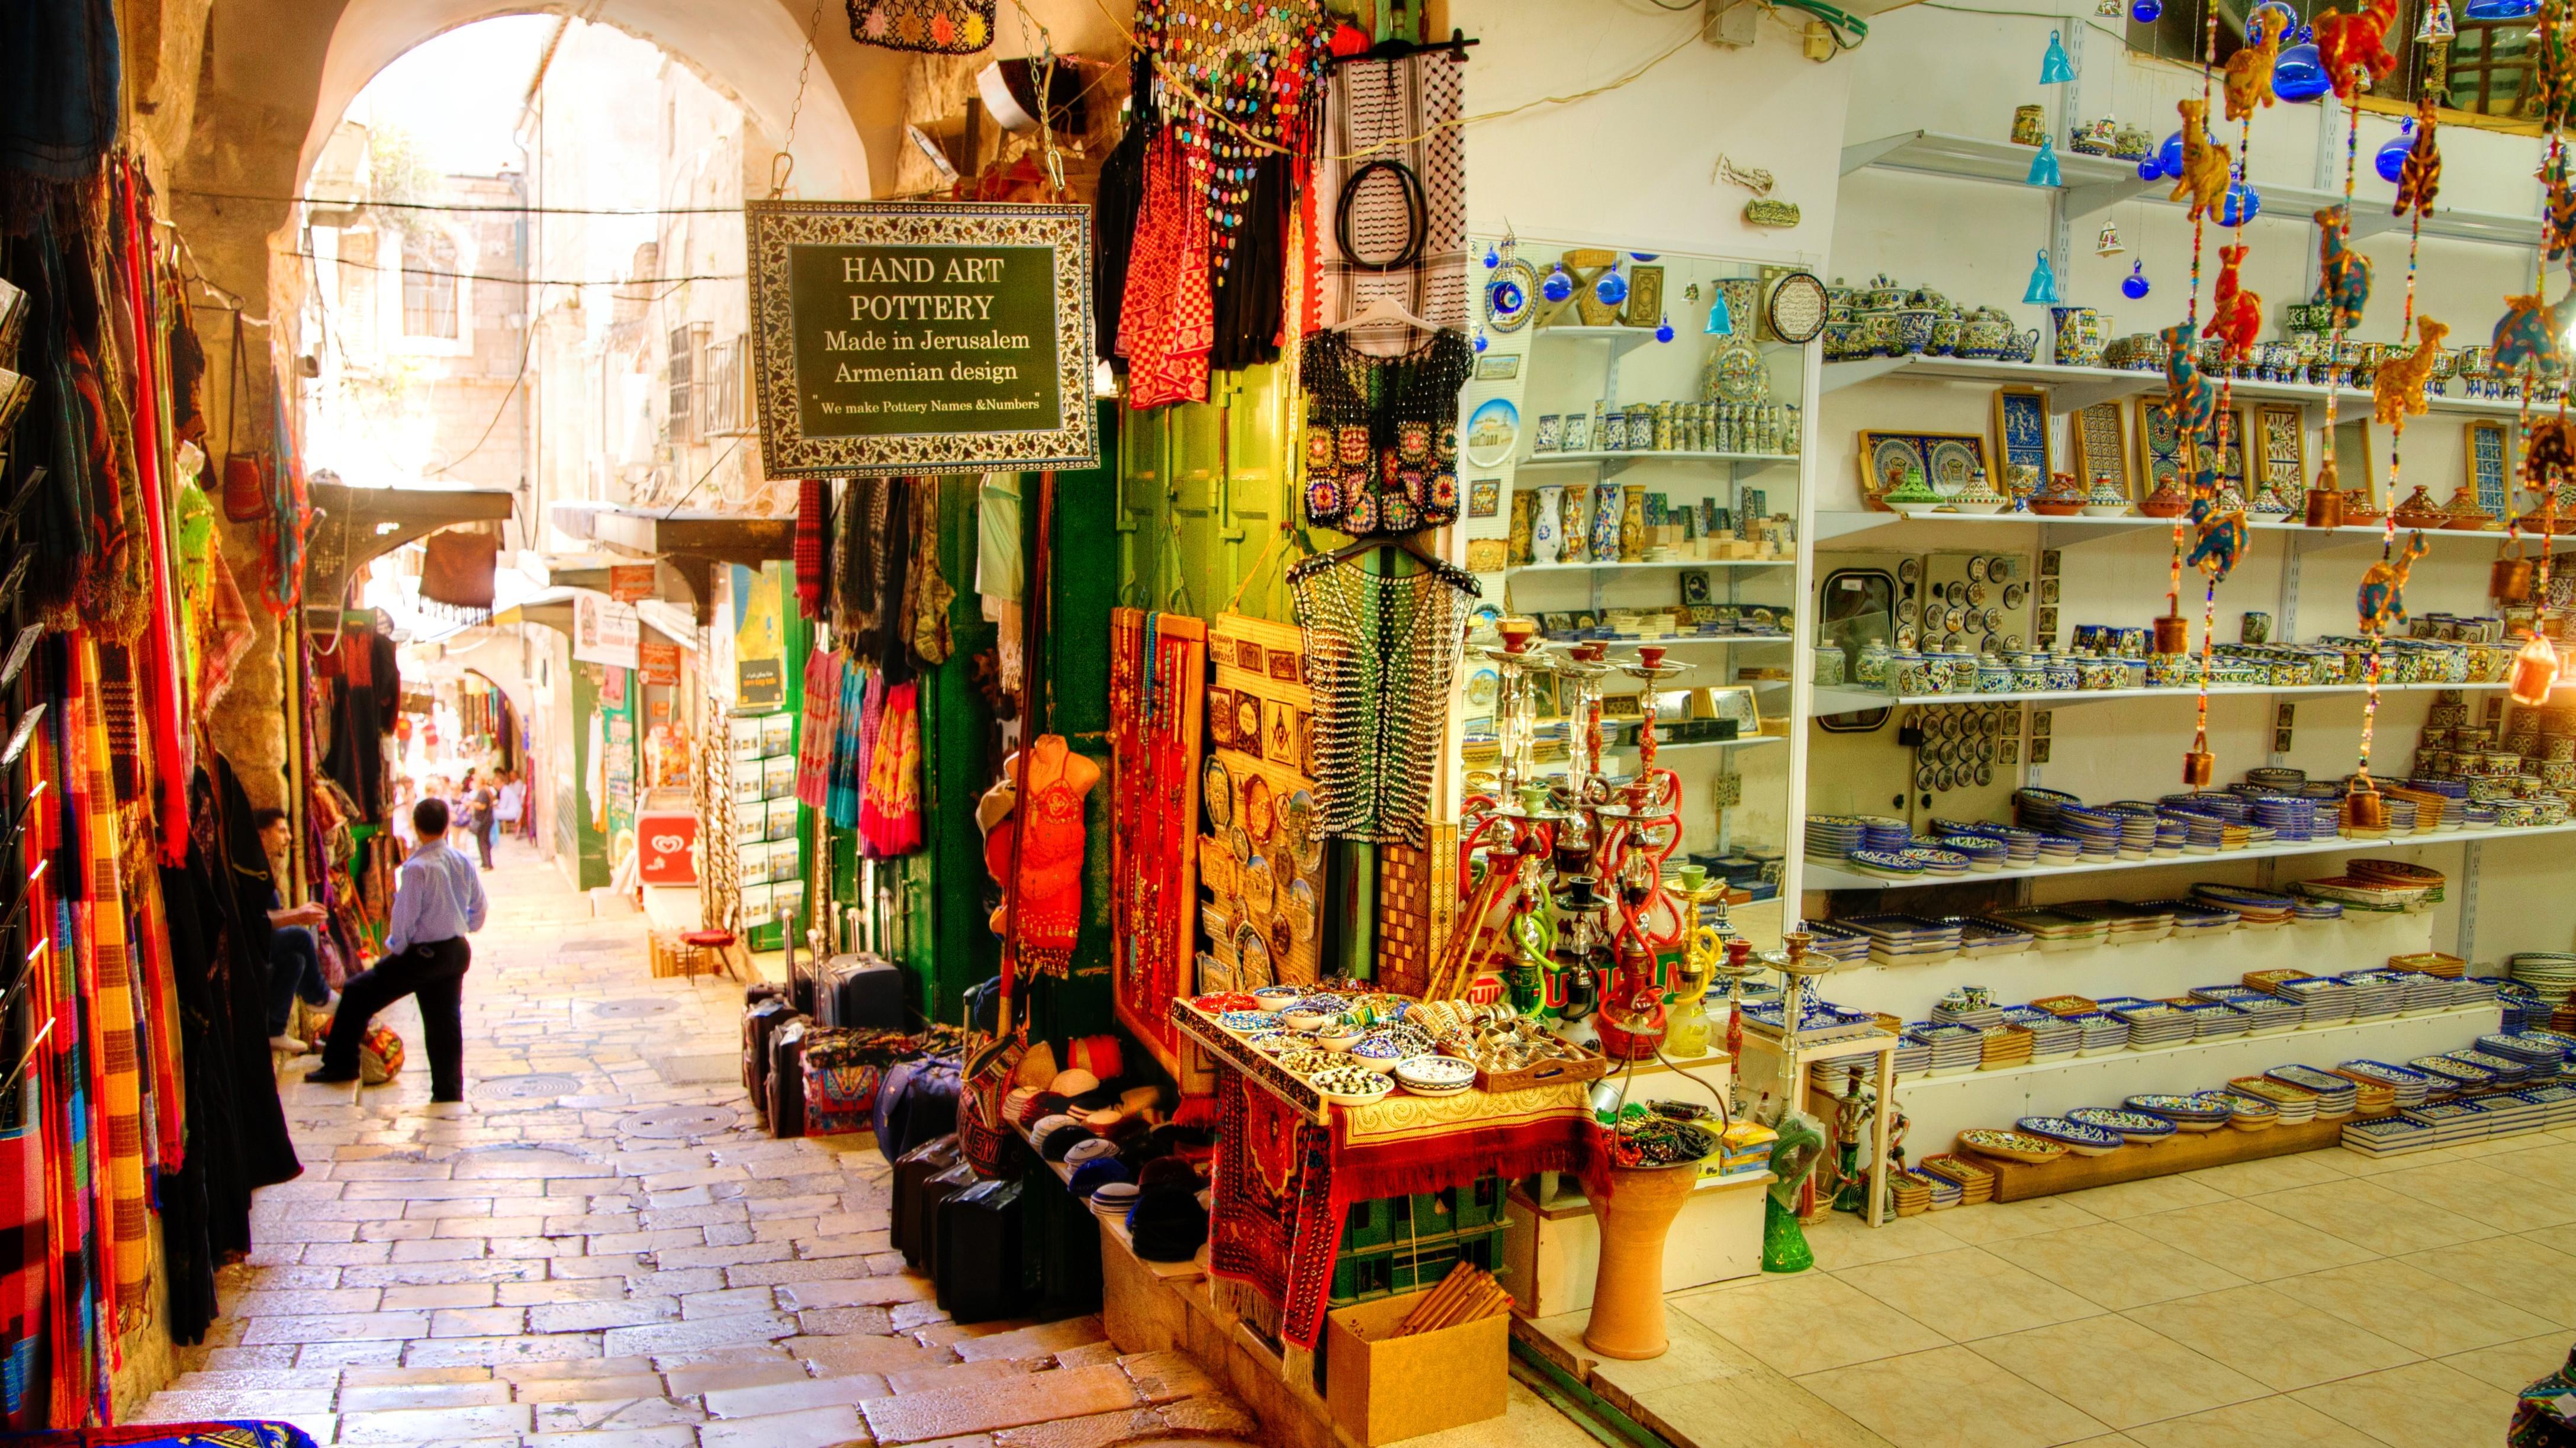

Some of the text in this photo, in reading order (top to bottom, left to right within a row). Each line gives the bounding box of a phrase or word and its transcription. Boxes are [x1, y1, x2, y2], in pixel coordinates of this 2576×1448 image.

[842, 258, 1004, 283] HAND ART
[850, 295, 995, 320] POTTERY
[824, 329, 1031, 351] Made in Jerusalem
[834, 361, 1018, 384] Armenian design
[845, 401, 880, 413] make
[883, 401, 928, 414] Pottery
[930, 400, 973, 411] Names
